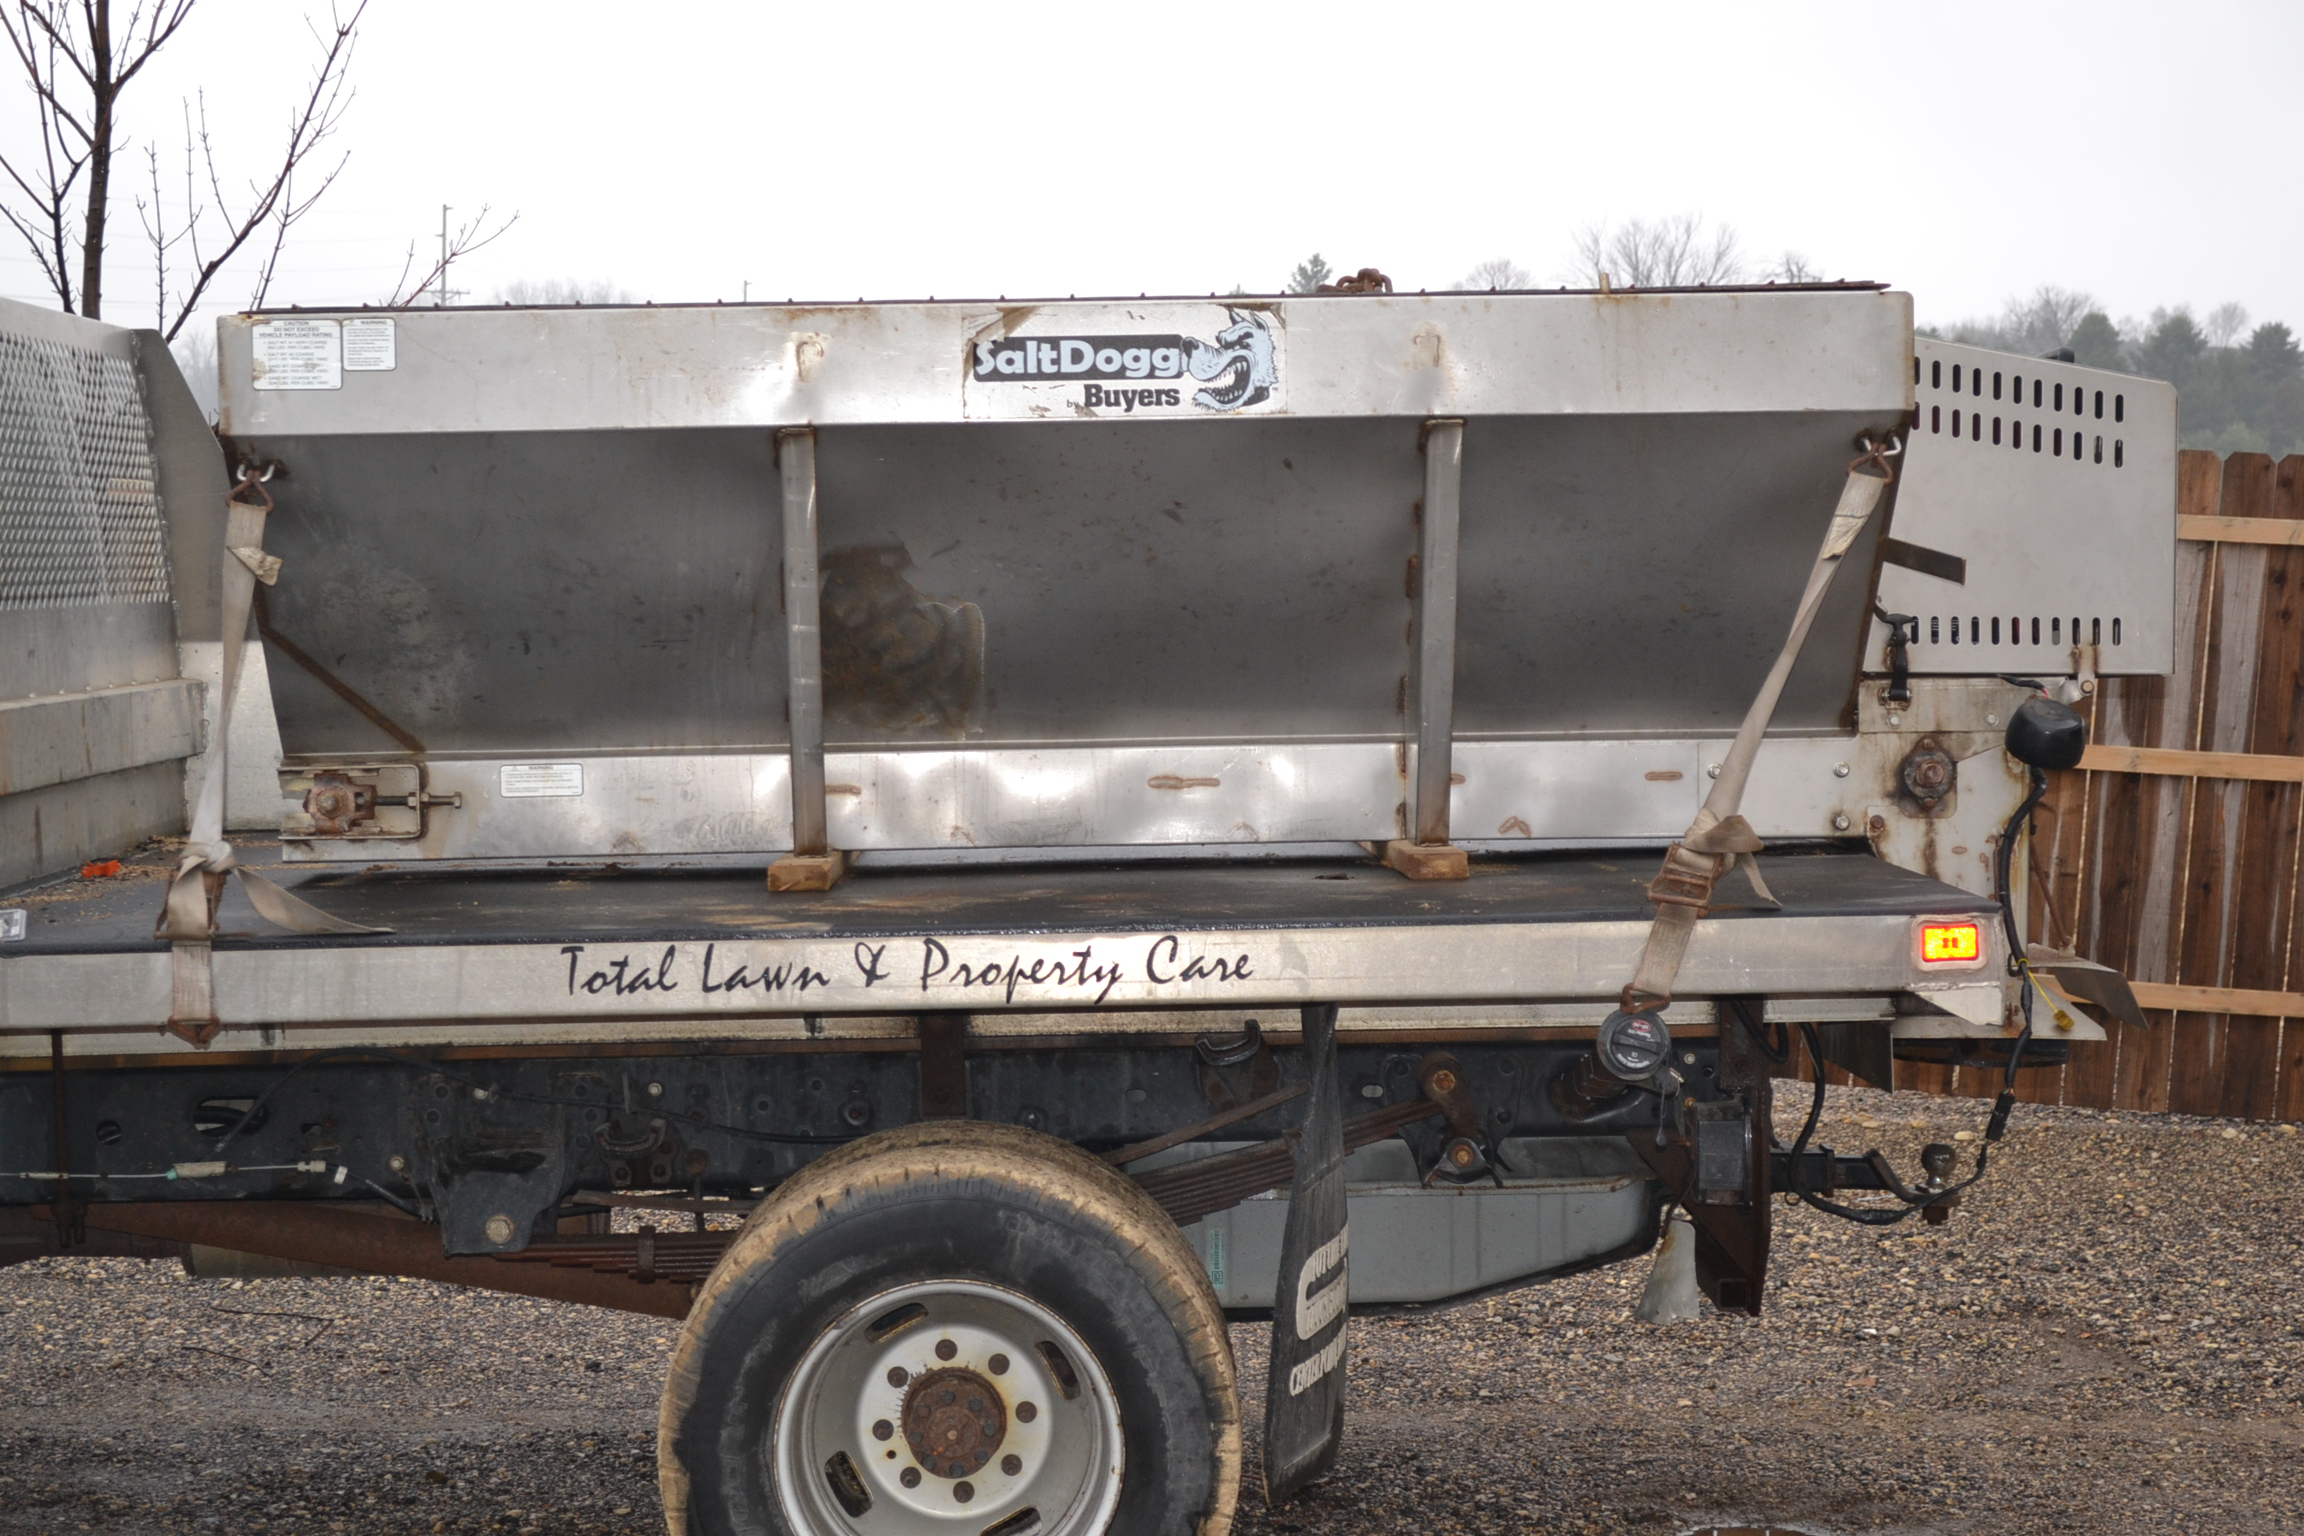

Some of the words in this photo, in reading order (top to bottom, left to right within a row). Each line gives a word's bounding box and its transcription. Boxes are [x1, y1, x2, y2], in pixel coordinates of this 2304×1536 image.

[974, 340, 1183, 378] SaltDogg
[1083, 383, 1181, 413] Buyers
[561, 944, 678, 996] Total
[702, 943, 830, 993] Lawn
[854, 942, 888, 988] &
[922, 937, 1120, 1004] Property
[1146, 934, 1252, 985] Care
